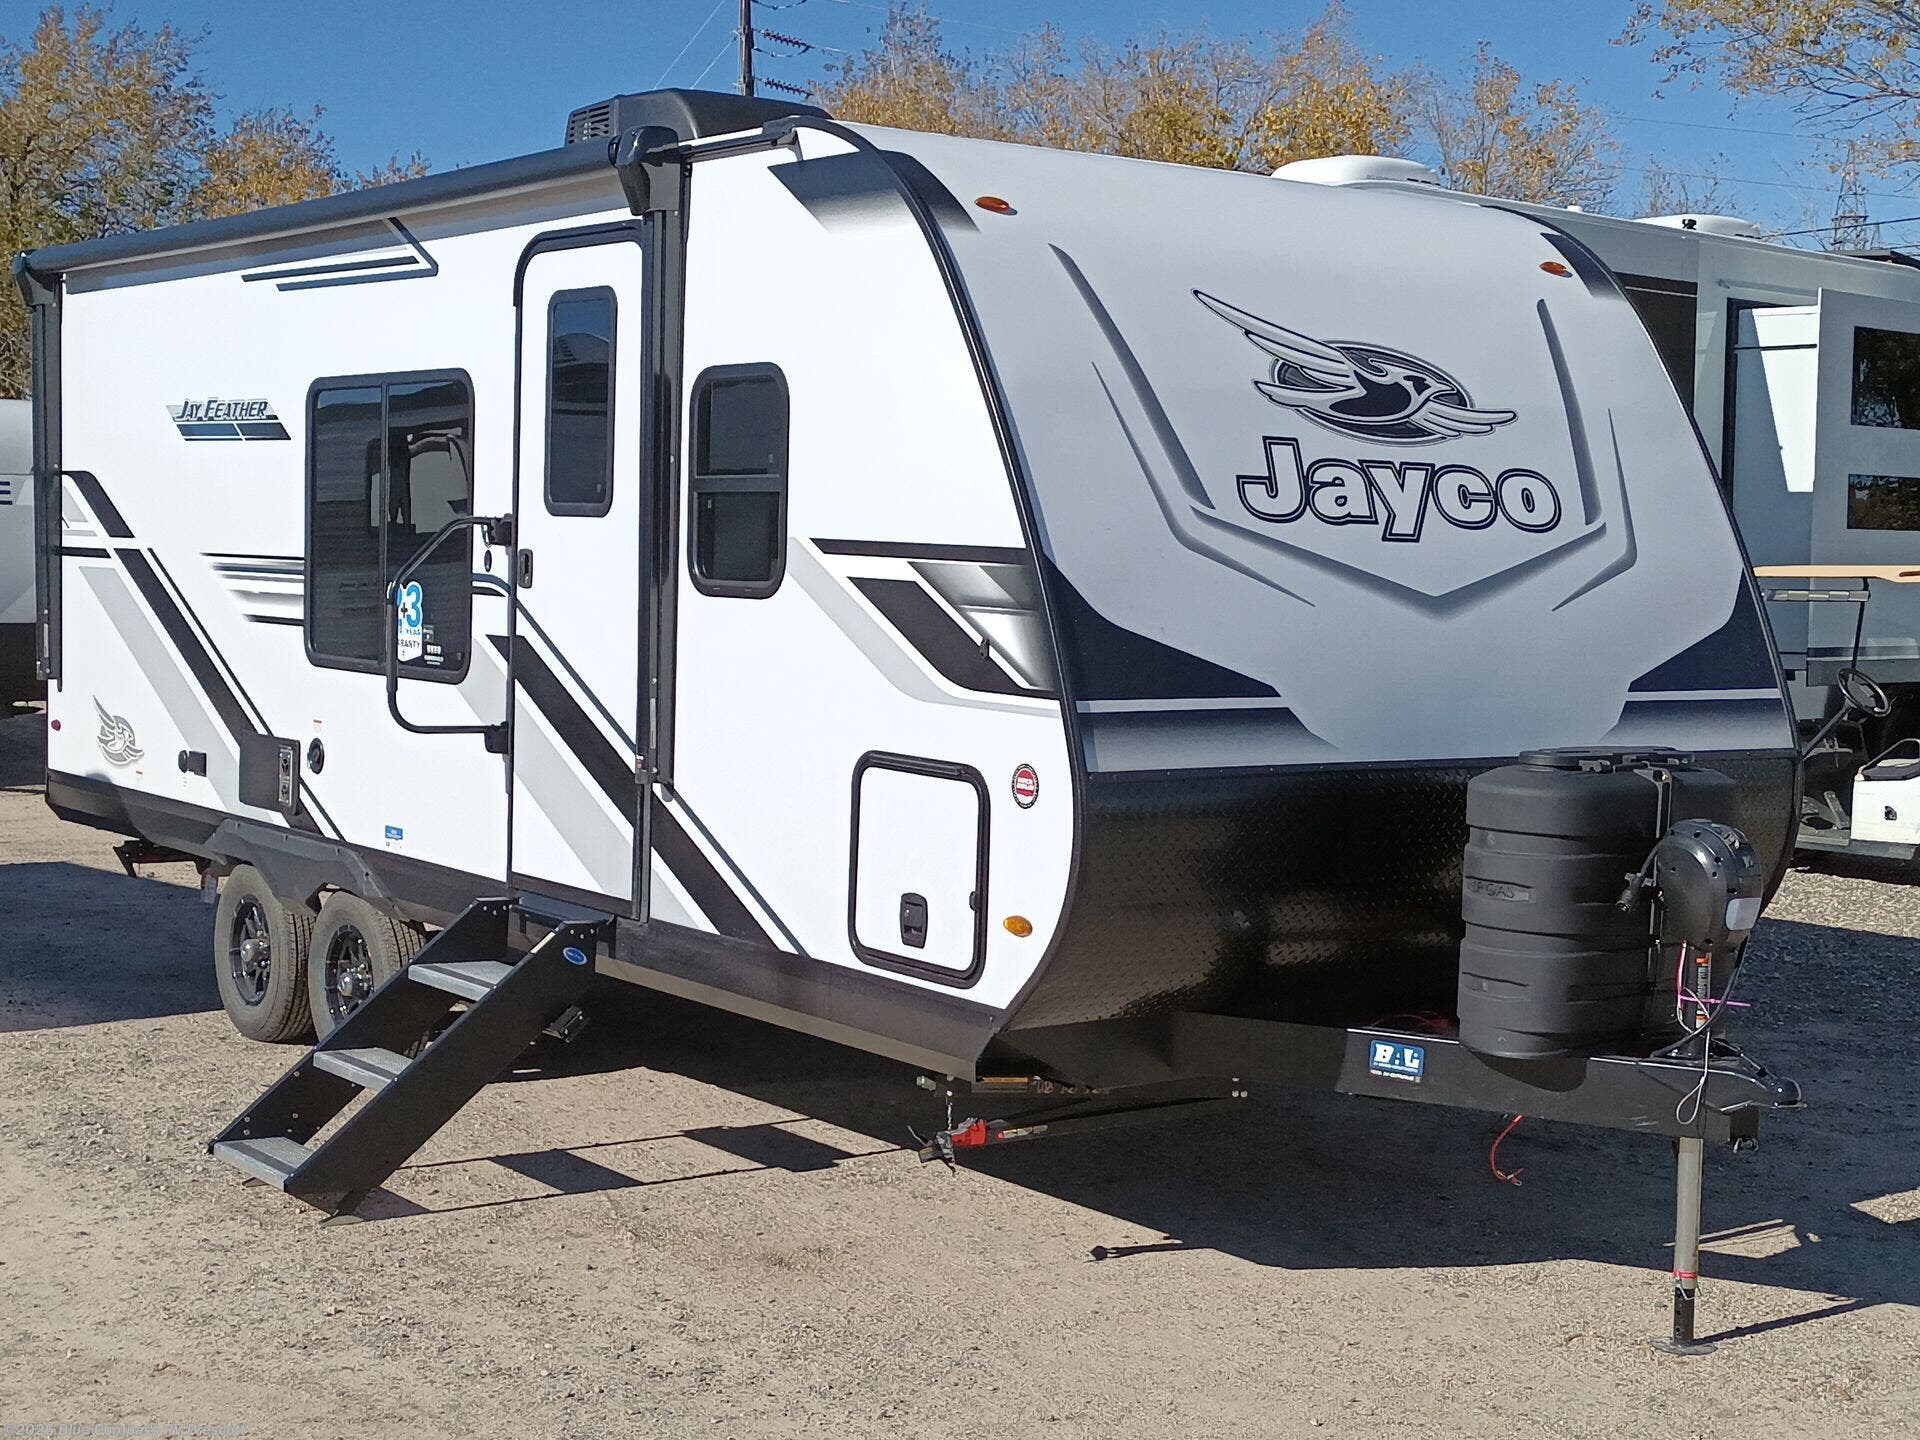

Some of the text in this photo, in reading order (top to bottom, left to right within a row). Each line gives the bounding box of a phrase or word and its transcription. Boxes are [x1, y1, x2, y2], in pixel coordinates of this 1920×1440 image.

[176, 399, 268, 419] JAY FEATHER
[1236, 435, 1562, 543] Jayco
